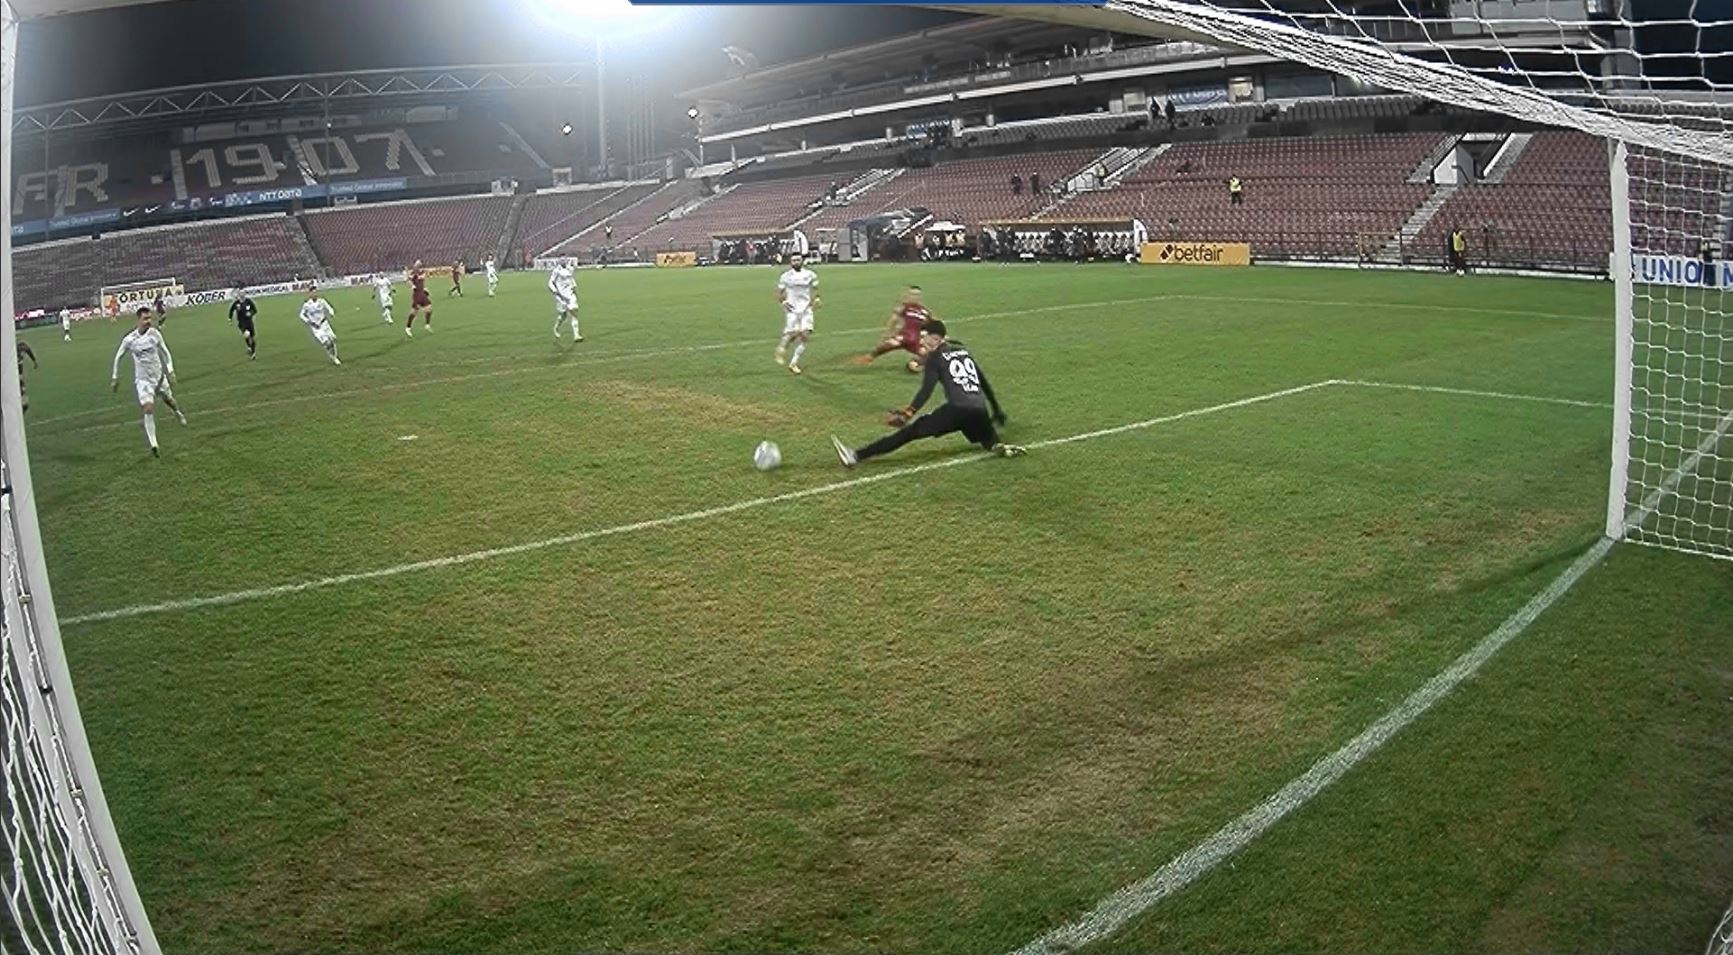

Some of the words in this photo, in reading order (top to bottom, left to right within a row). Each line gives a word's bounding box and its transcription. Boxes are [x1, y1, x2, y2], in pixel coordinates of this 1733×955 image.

[259, 191, 277, 202] NTT
[1174, 244, 1224, 261] betfair
[949, 353, 980, 384] 99
